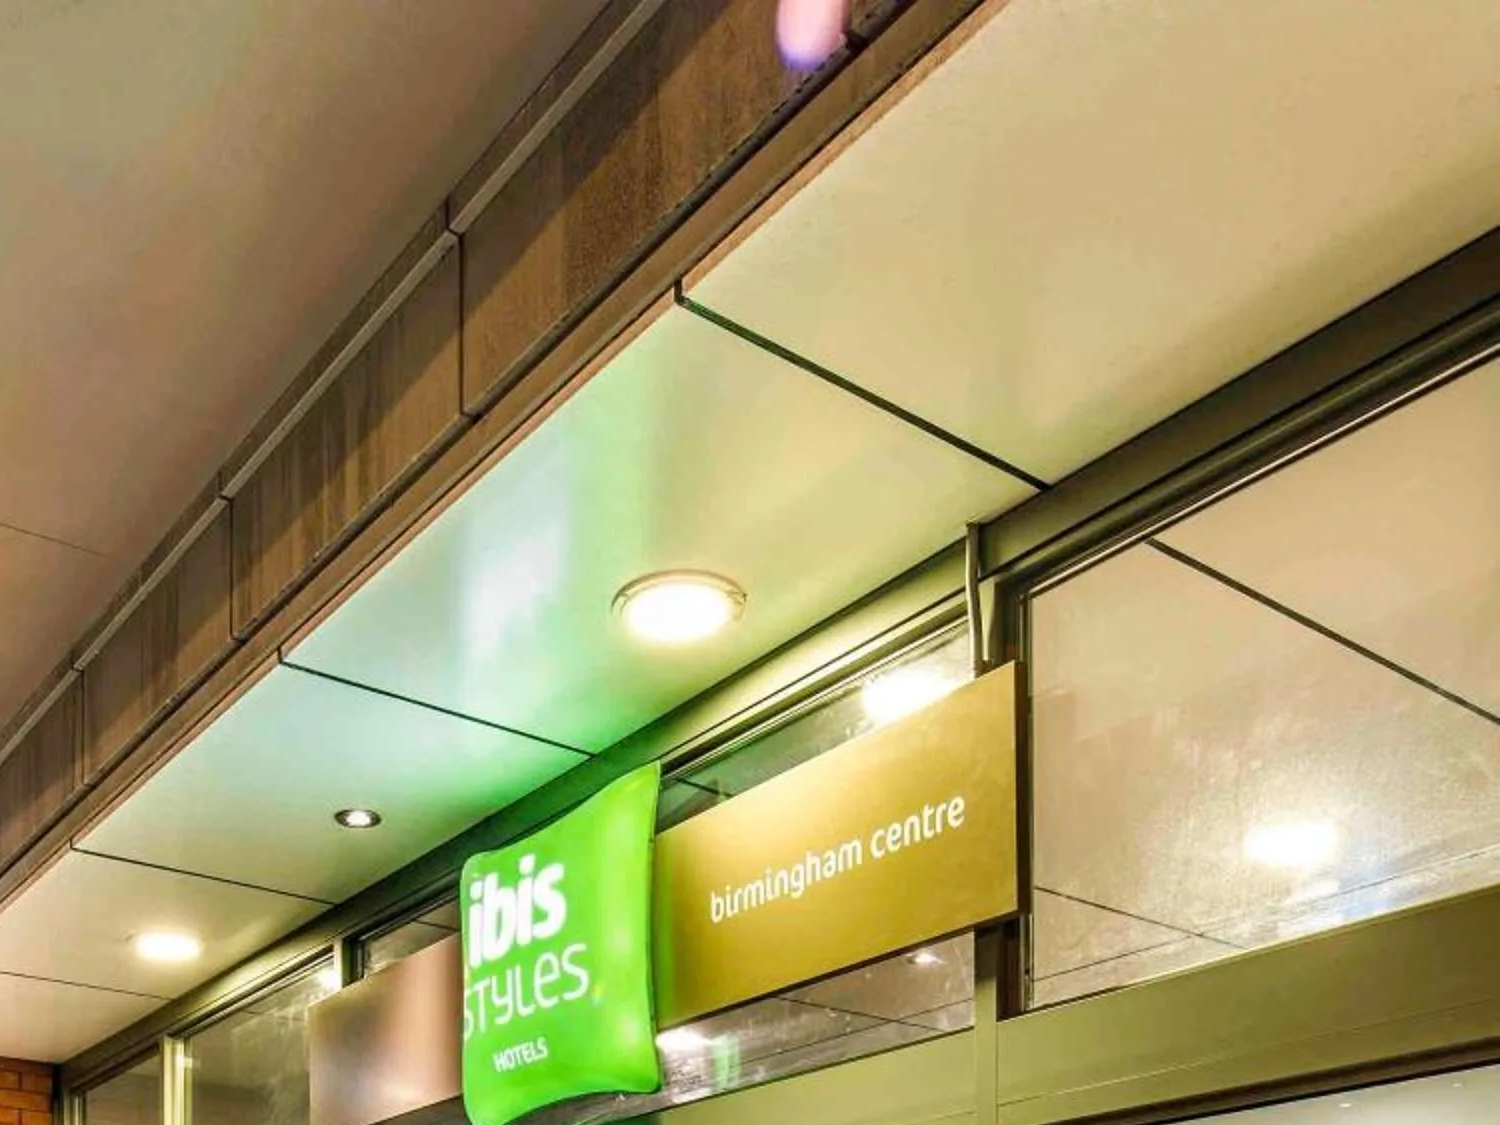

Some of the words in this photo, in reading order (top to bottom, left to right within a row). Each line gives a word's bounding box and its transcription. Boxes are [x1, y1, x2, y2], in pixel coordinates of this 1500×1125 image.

[469, 853, 567, 969] ibis
[710, 836, 863, 924] birmingham
[870, 796, 965, 859] centre
[492, 1036, 548, 1072] HOTELS
